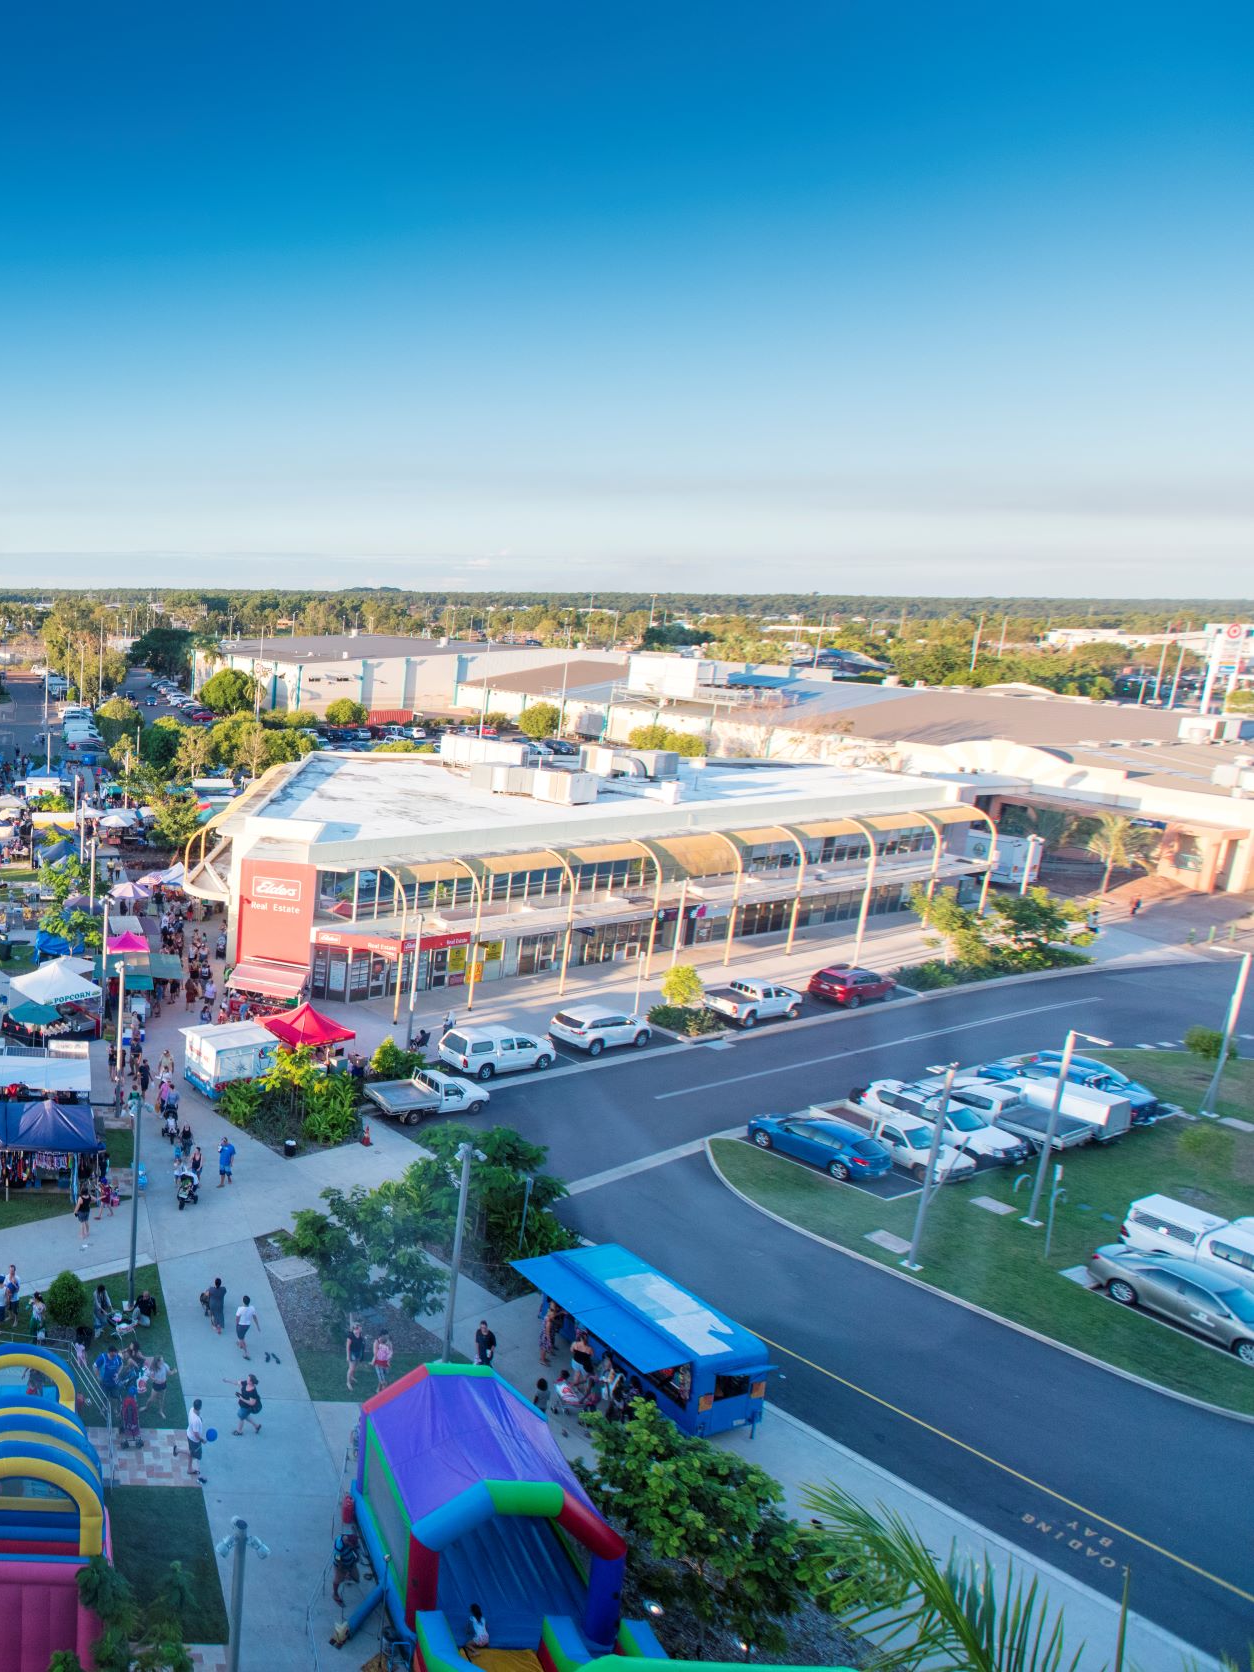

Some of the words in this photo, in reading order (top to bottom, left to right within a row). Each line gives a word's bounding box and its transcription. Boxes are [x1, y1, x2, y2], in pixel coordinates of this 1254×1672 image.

[256, 881, 298, 897] Elders
[251, 901, 268, 911] Real
[273, 903, 301, 914] Estate
[380, 943, 397, 951] Estate
[54, 991, 91, 1003] POPCORN
[1067, 1521, 1113, 1548] BAY
